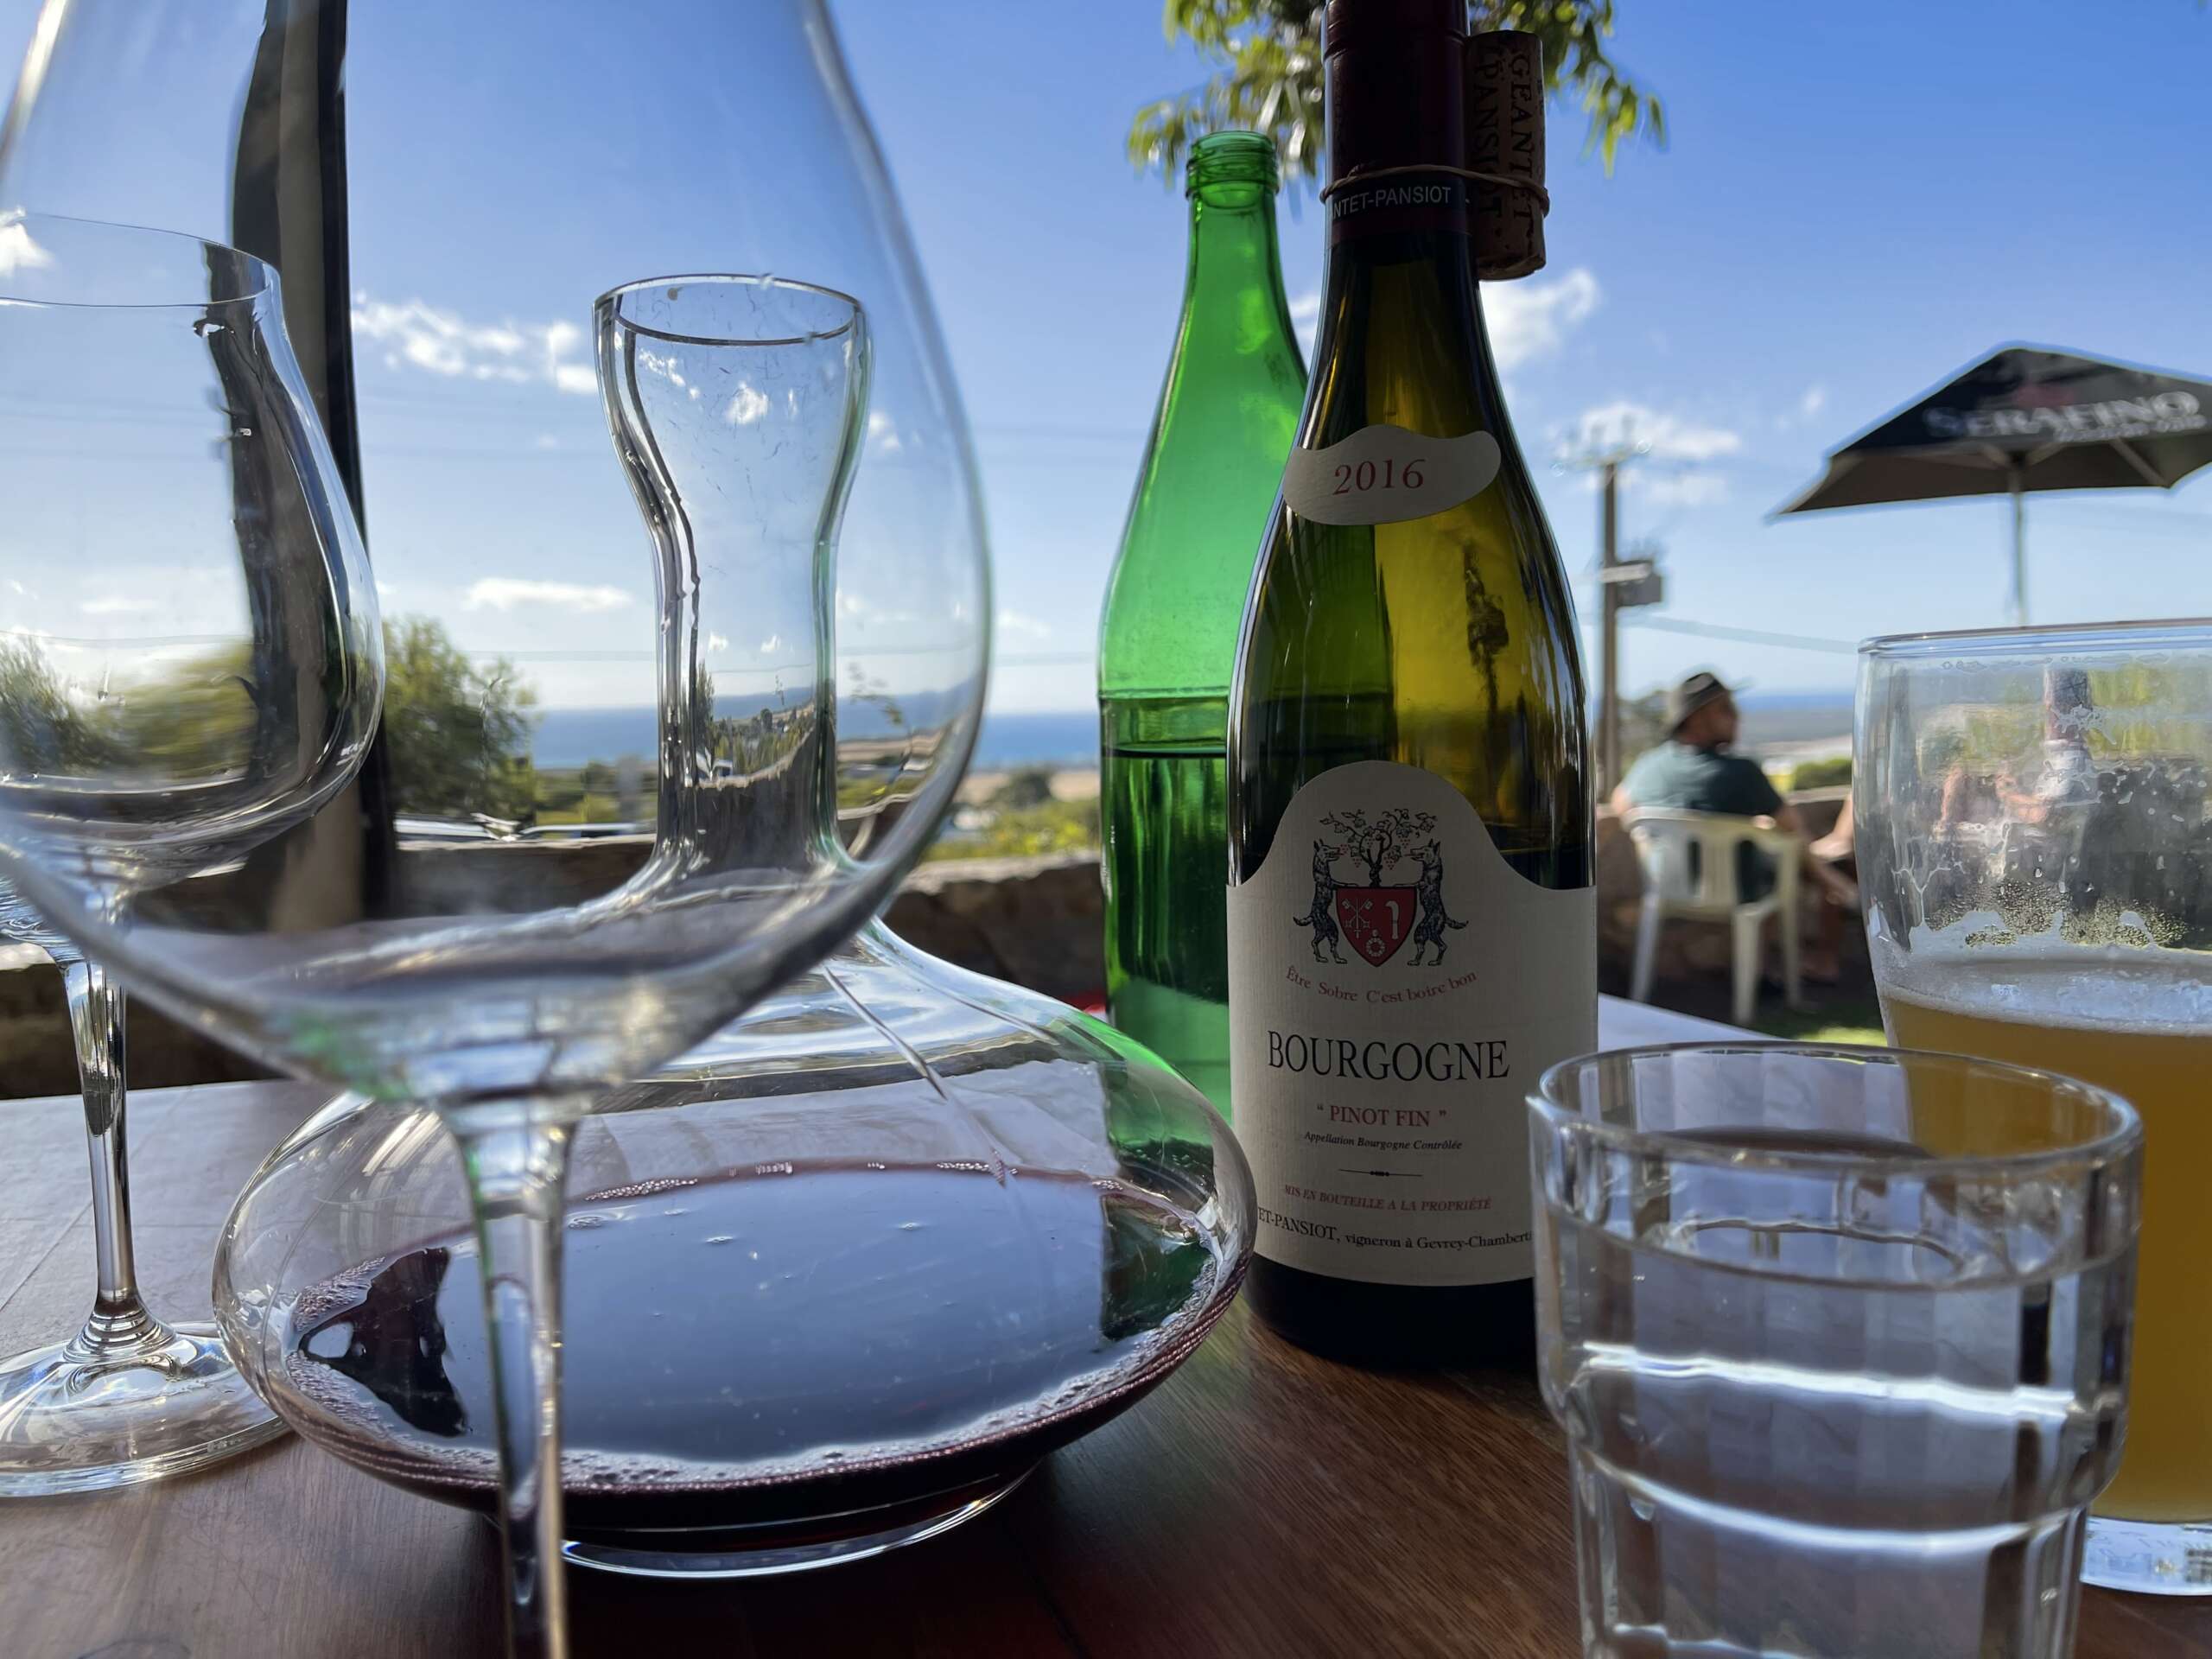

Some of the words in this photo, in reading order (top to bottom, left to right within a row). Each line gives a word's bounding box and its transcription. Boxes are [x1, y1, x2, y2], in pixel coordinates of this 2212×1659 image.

[1332, 185, 1452, 219] NTET-PANSIOT
[1332, 459, 1426, 496] 2016
[1286, 964, 1312, 989] Être
[1318, 982, 1358, 1002] Sobre
[1365, 988, 1403, 1003] C'est
[1407, 982, 1446, 1002] boire
[1448, 969, 1478, 990] bon
[1268, 1030, 1511, 1082] BOURGOGNE
[1304, 1130, 1355, 1147] Appellation
[1357, 1136, 1410, 1151] Bourgogne
[1303, 1189, 1317, 1201] EN
[1319, 1192, 1385, 1210] BOUTEILLE
[1400, 1200, 1416, 1211] LA
[1258, 1206, 1340, 1243] ET-PANSIOT,
[1344, 1232, 1402, 1248] vigneron
[1405, 1236, 1414, 1249] à
[1417, 1230, 1534, 1251] Gevrey-Chamberti
